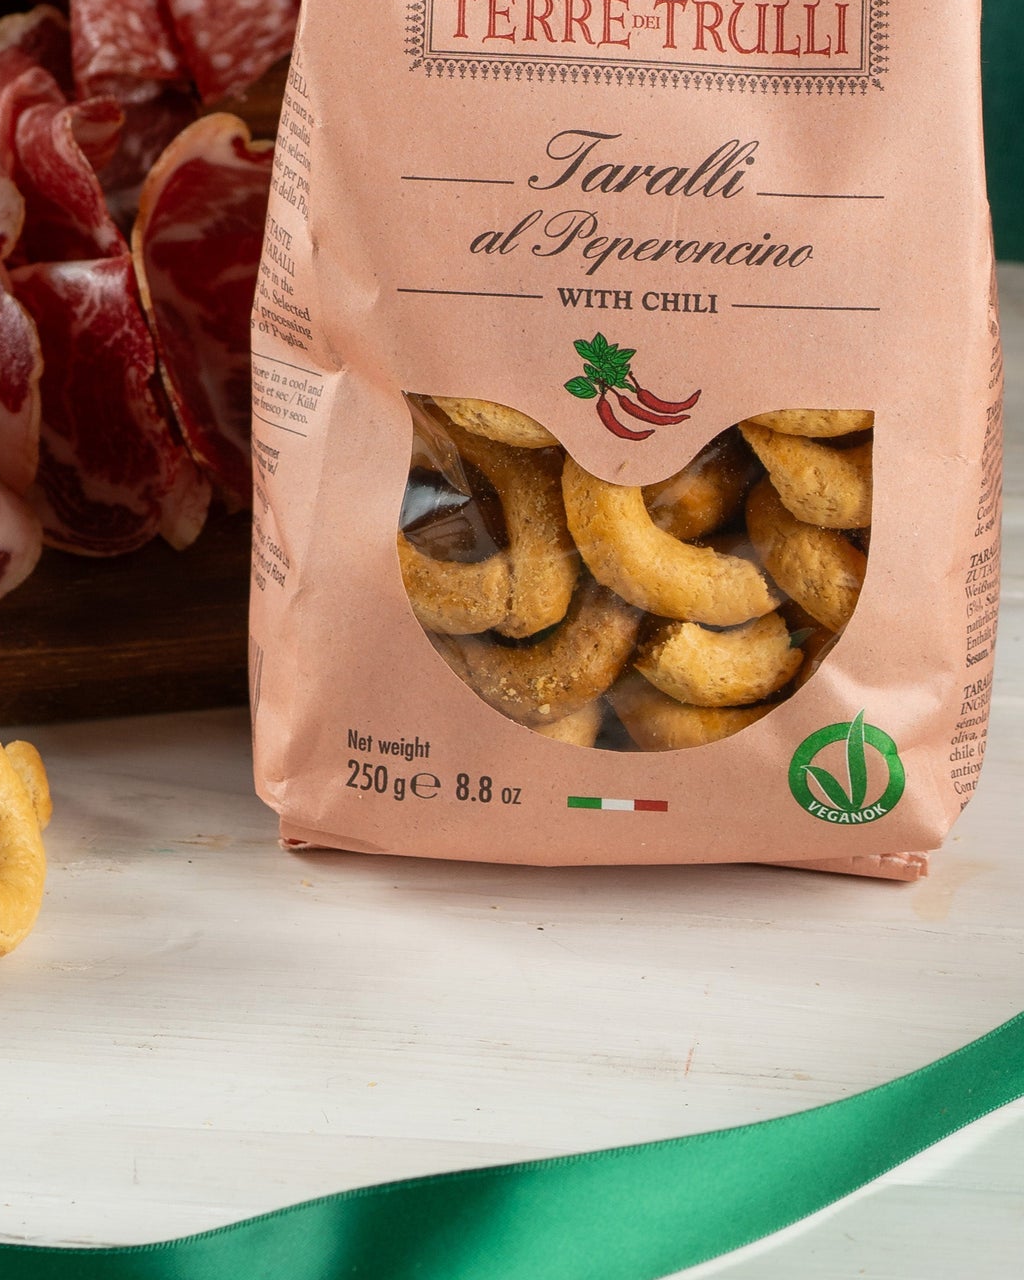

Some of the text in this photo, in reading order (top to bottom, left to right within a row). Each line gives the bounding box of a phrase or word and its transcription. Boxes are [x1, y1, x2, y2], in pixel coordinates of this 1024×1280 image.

[631, 12, 661, 32] DEI
[527, 129, 760, 200] Taralli
[470, 209, 814, 276] al Peperoncino
[272, 289, 312, 322] Selected
[557, 287, 718, 314] WITH CHILI
[261, 306, 313, 341] processing
[271, 369, 281, 383] in
[281, 377, 288, 386] a
[289, 379, 308, 392] cool
[307, 385, 325, 398] and
[348, 729, 430, 761] Net weight
[949, 744, 975, 762] chile
[346, 759, 388, 793] 250
[456, 773, 492, 803] 8.8
[501, 787, 522, 805] oz
[807, 801, 888, 823] VEGANOK
